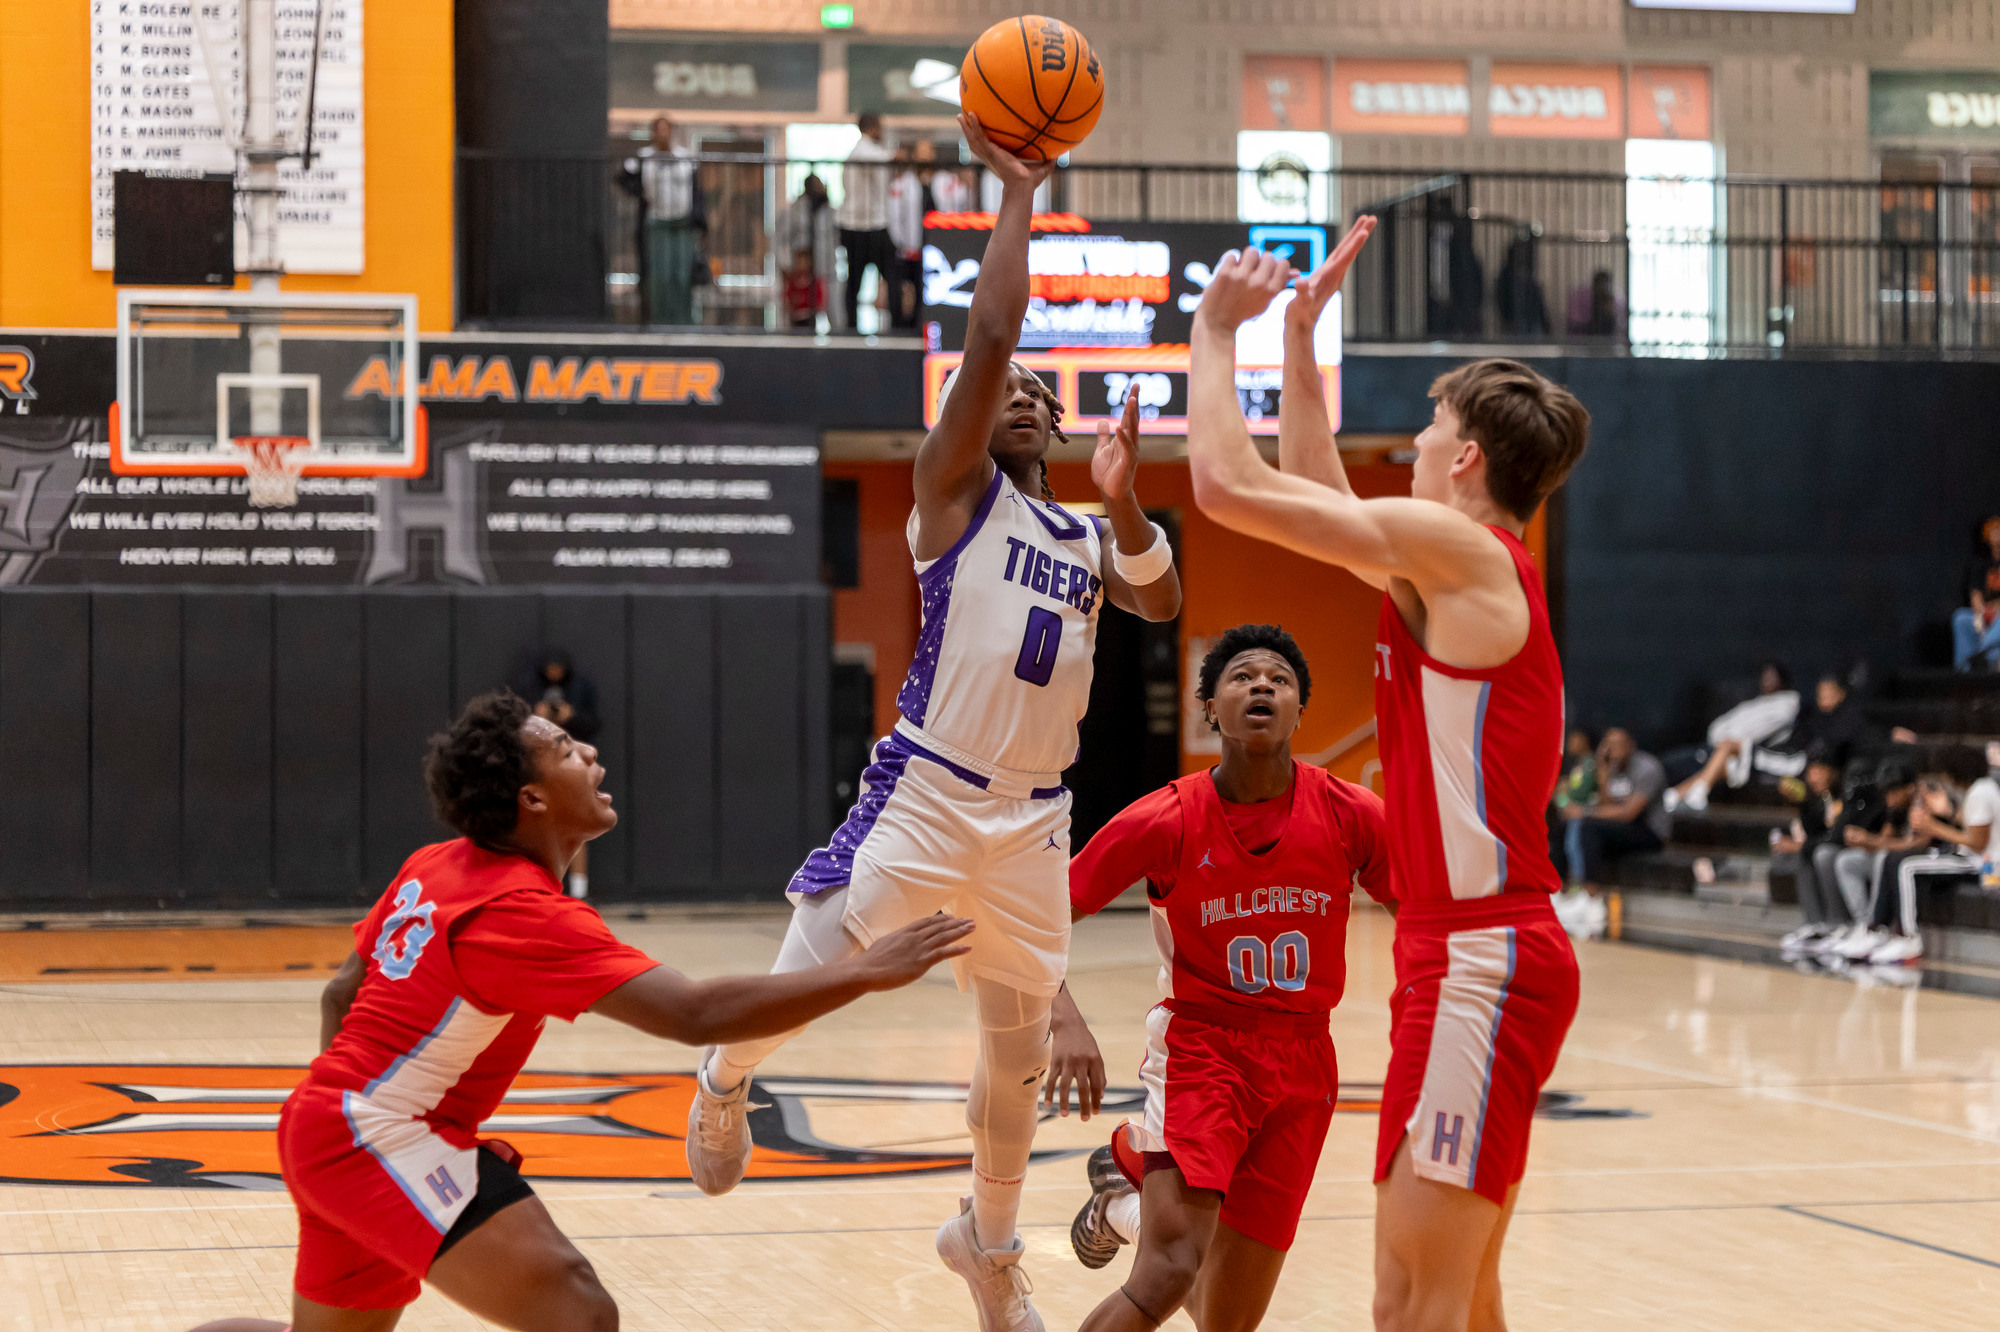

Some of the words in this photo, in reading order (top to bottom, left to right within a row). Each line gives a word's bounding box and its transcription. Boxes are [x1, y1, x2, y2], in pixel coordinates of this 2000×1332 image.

[140, 5, 221, 17] BOLEWRE
[141, 45, 191, 58] BURNS
[142, 66, 190, 78] GLASS
[142, 86, 190, 99] GATES
[141, 106, 193, 119] MASON
[137, 127, 222, 139] WASHINGTON
[524, 356, 723, 405] MATER
[75, 477, 114, 495] ALL
[116, 477, 160, 495] OUR
[161, 477, 230, 495] WHOLE
[507, 477, 546, 497] ALL
[546, 478, 590, 498] OUR
[69, 512, 101, 530] WE
[103, 512, 149, 530] WILL
[151, 512, 205, 530] EVER
[206, 512, 260, 531] HOLD
[261, 512, 315, 531] YOUR
[486, 512, 519, 532] WE
[519, 512, 565, 533] WILL
[120, 547, 200, 565] HOOVER
[250, 547, 292, 565] FOR
[552, 547, 608, 567] ALMA
[608, 547, 673, 568] MATER
[1003, 535, 1103, 616] TIGERS
[1014, 605, 1063, 688] 0
[1201, 886, 1332, 927] HILLCREST
[1227, 930, 1310, 994] 00
[1431, 1111, 1464, 1166] H
[424, 1165, 463, 1208] H
